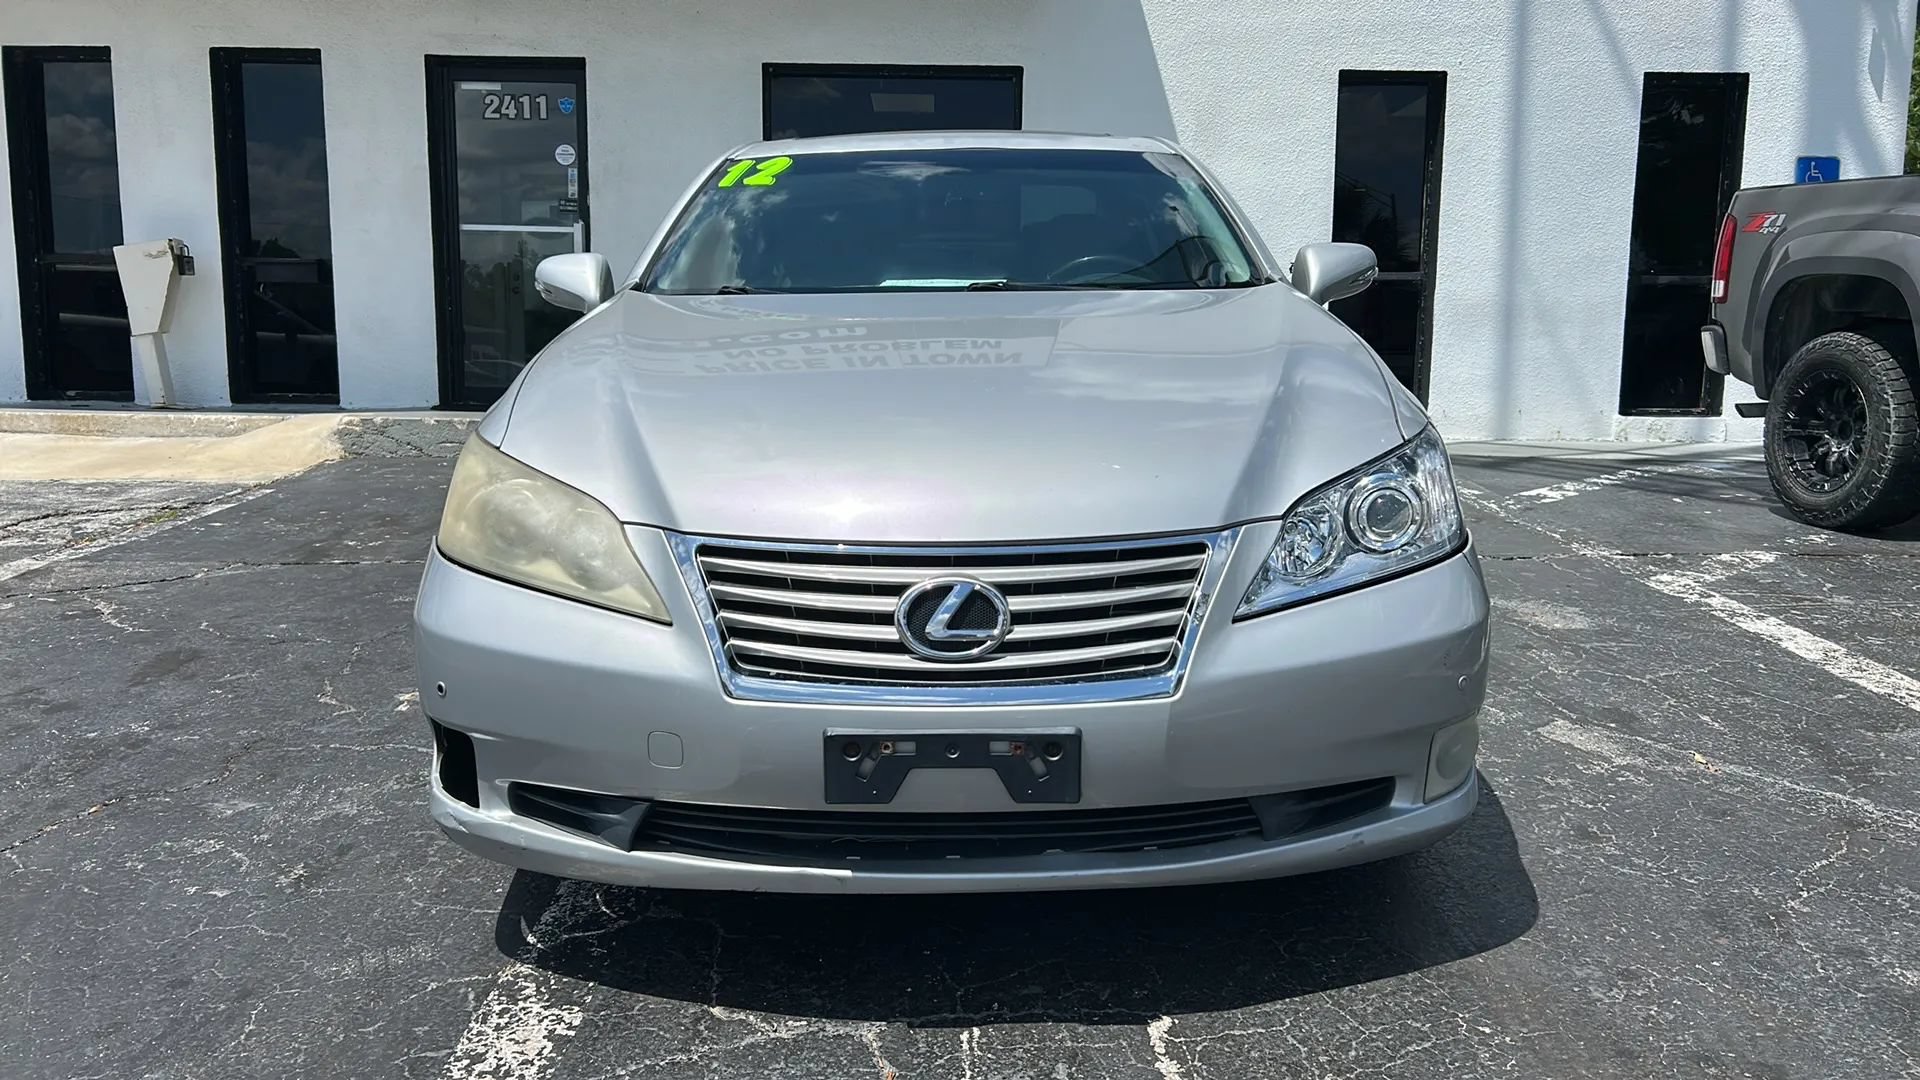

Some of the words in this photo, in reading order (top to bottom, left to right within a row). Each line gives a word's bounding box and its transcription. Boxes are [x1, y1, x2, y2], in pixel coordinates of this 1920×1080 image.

[482, 94, 548, 120] 2411
[718, 156, 793, 187] 12
[1742, 211, 1787, 232] Z71
